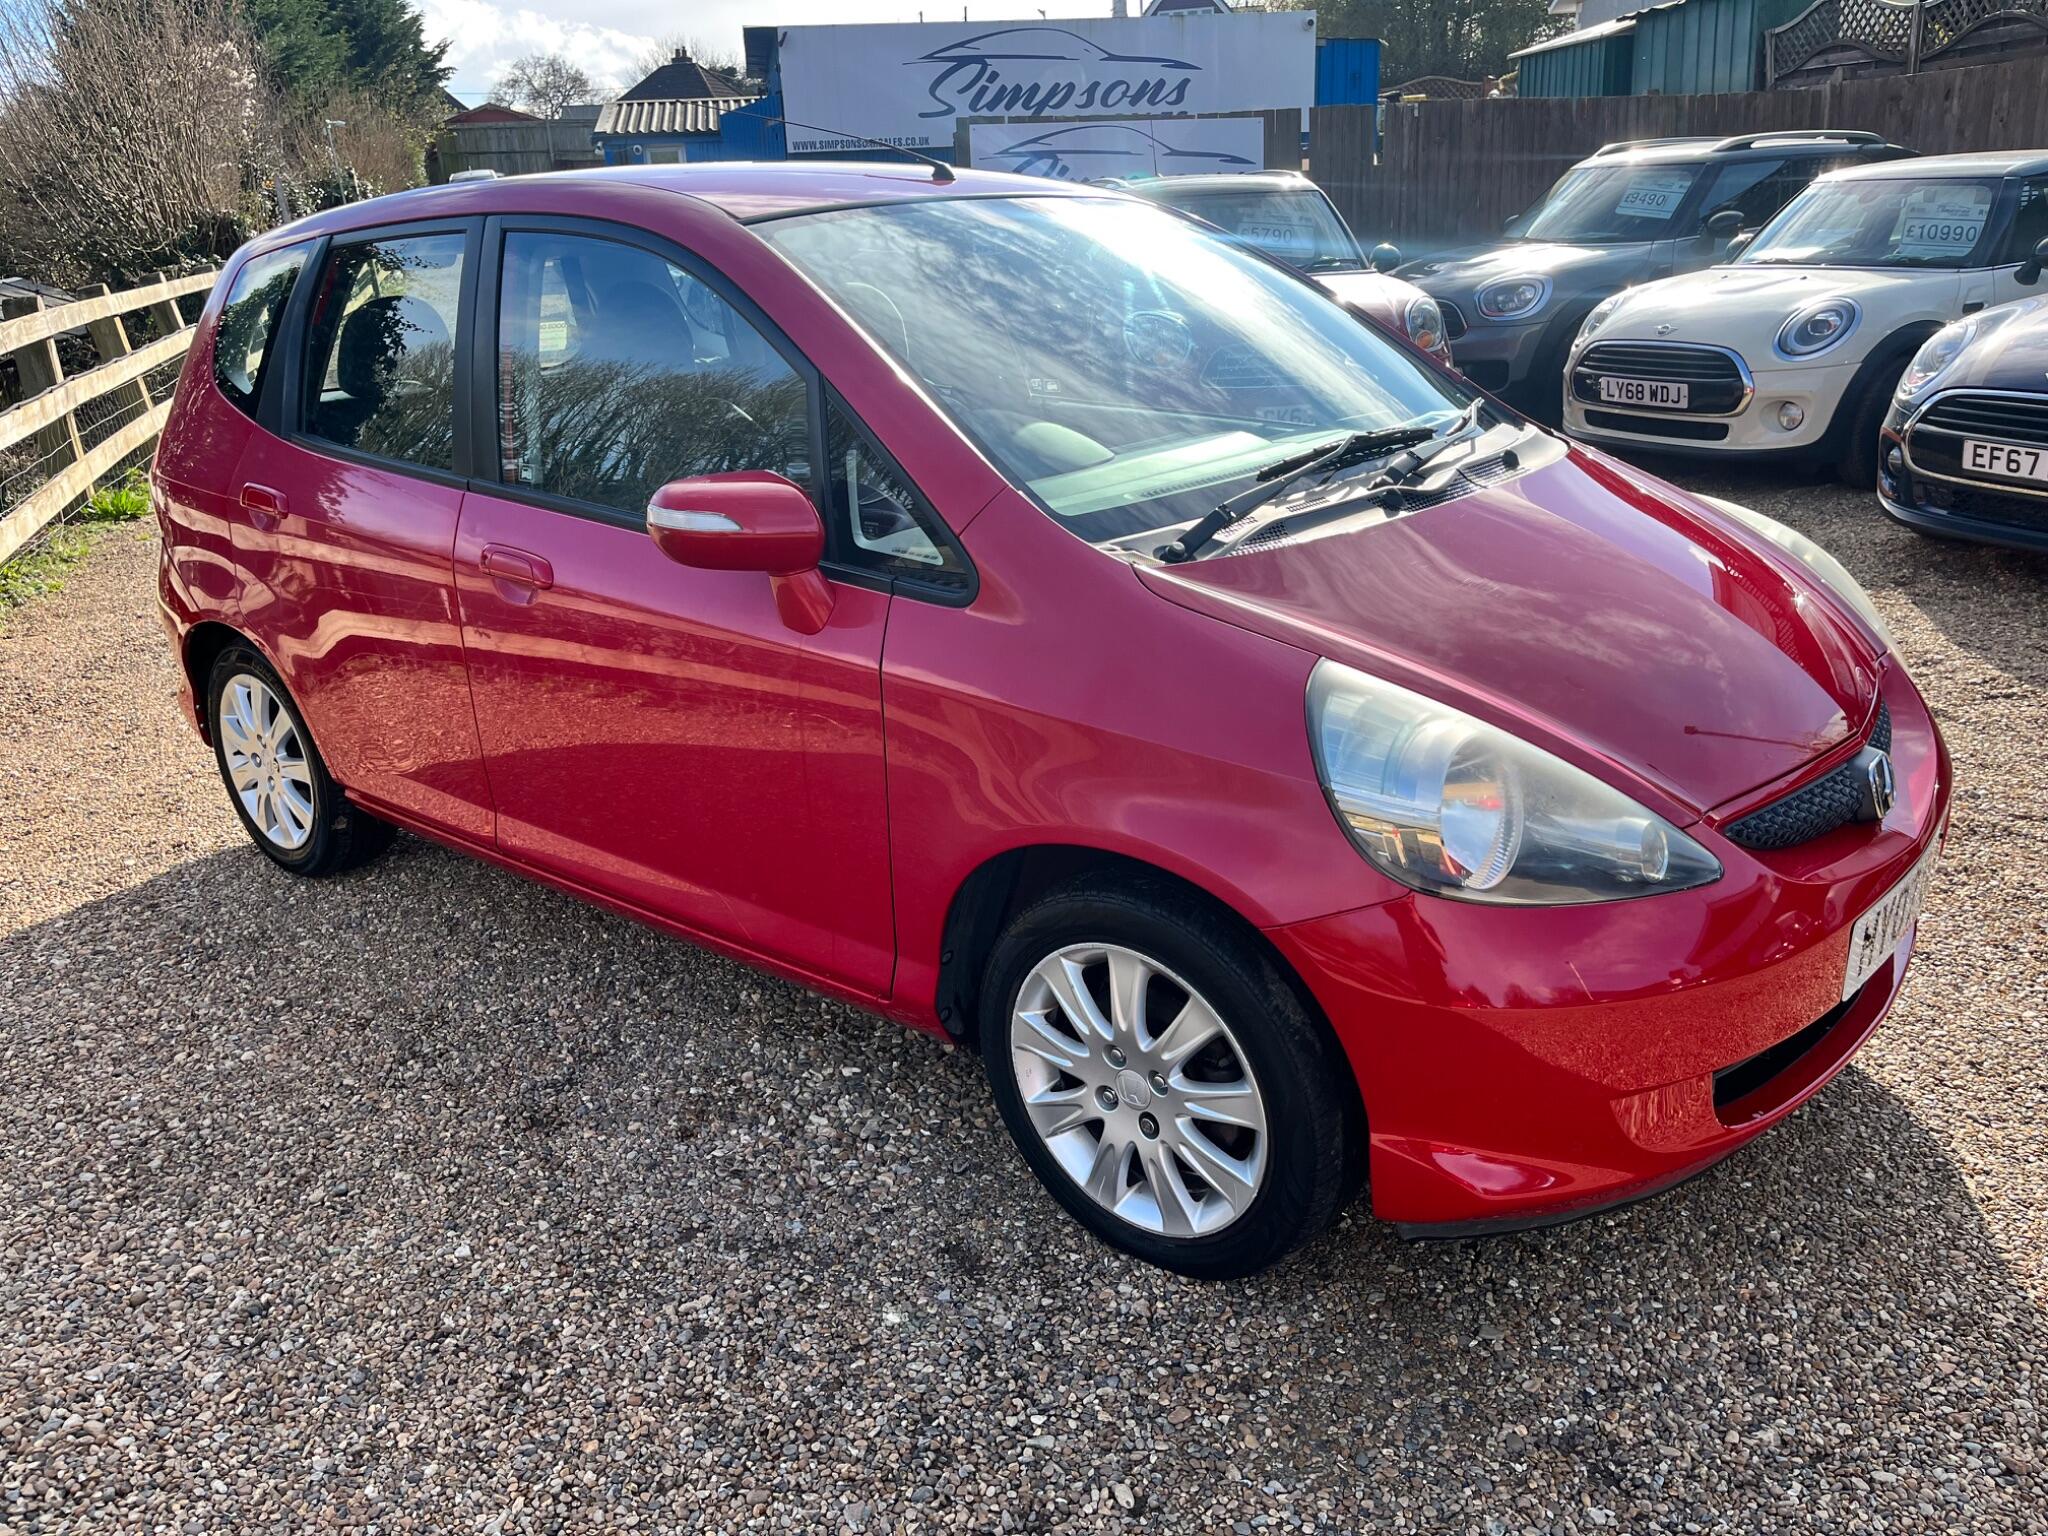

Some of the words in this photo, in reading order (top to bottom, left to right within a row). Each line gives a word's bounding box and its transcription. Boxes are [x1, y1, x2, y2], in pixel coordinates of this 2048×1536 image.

[918, 56, 1191, 118] Simpsons
[1624, 191, 1666, 207] £9490
[1905, 224, 1977, 242] £10990
[1606, 380, 1645, 401] LY68
[1649, 384, 1681, 404] WDJ
[1971, 443, 2041, 476] EF67
